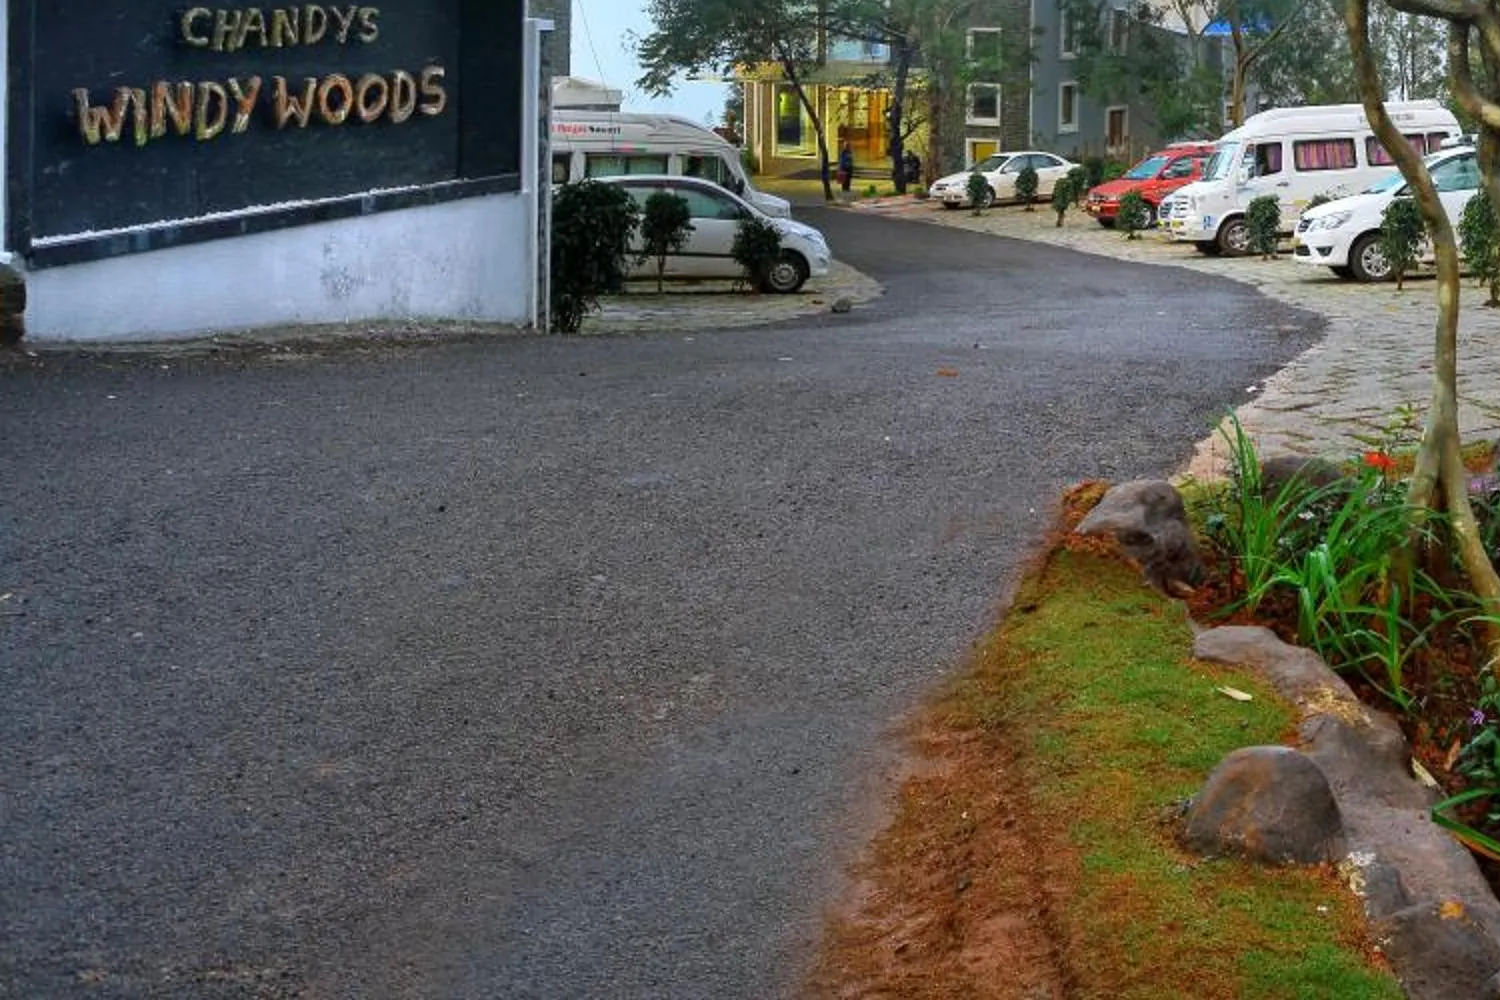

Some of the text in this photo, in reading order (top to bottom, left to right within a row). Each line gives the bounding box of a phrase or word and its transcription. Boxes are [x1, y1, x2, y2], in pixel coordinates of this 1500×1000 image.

[181, 5, 380, 51] CHANDYS
[73, 65, 448, 146] WINDY WOODS
